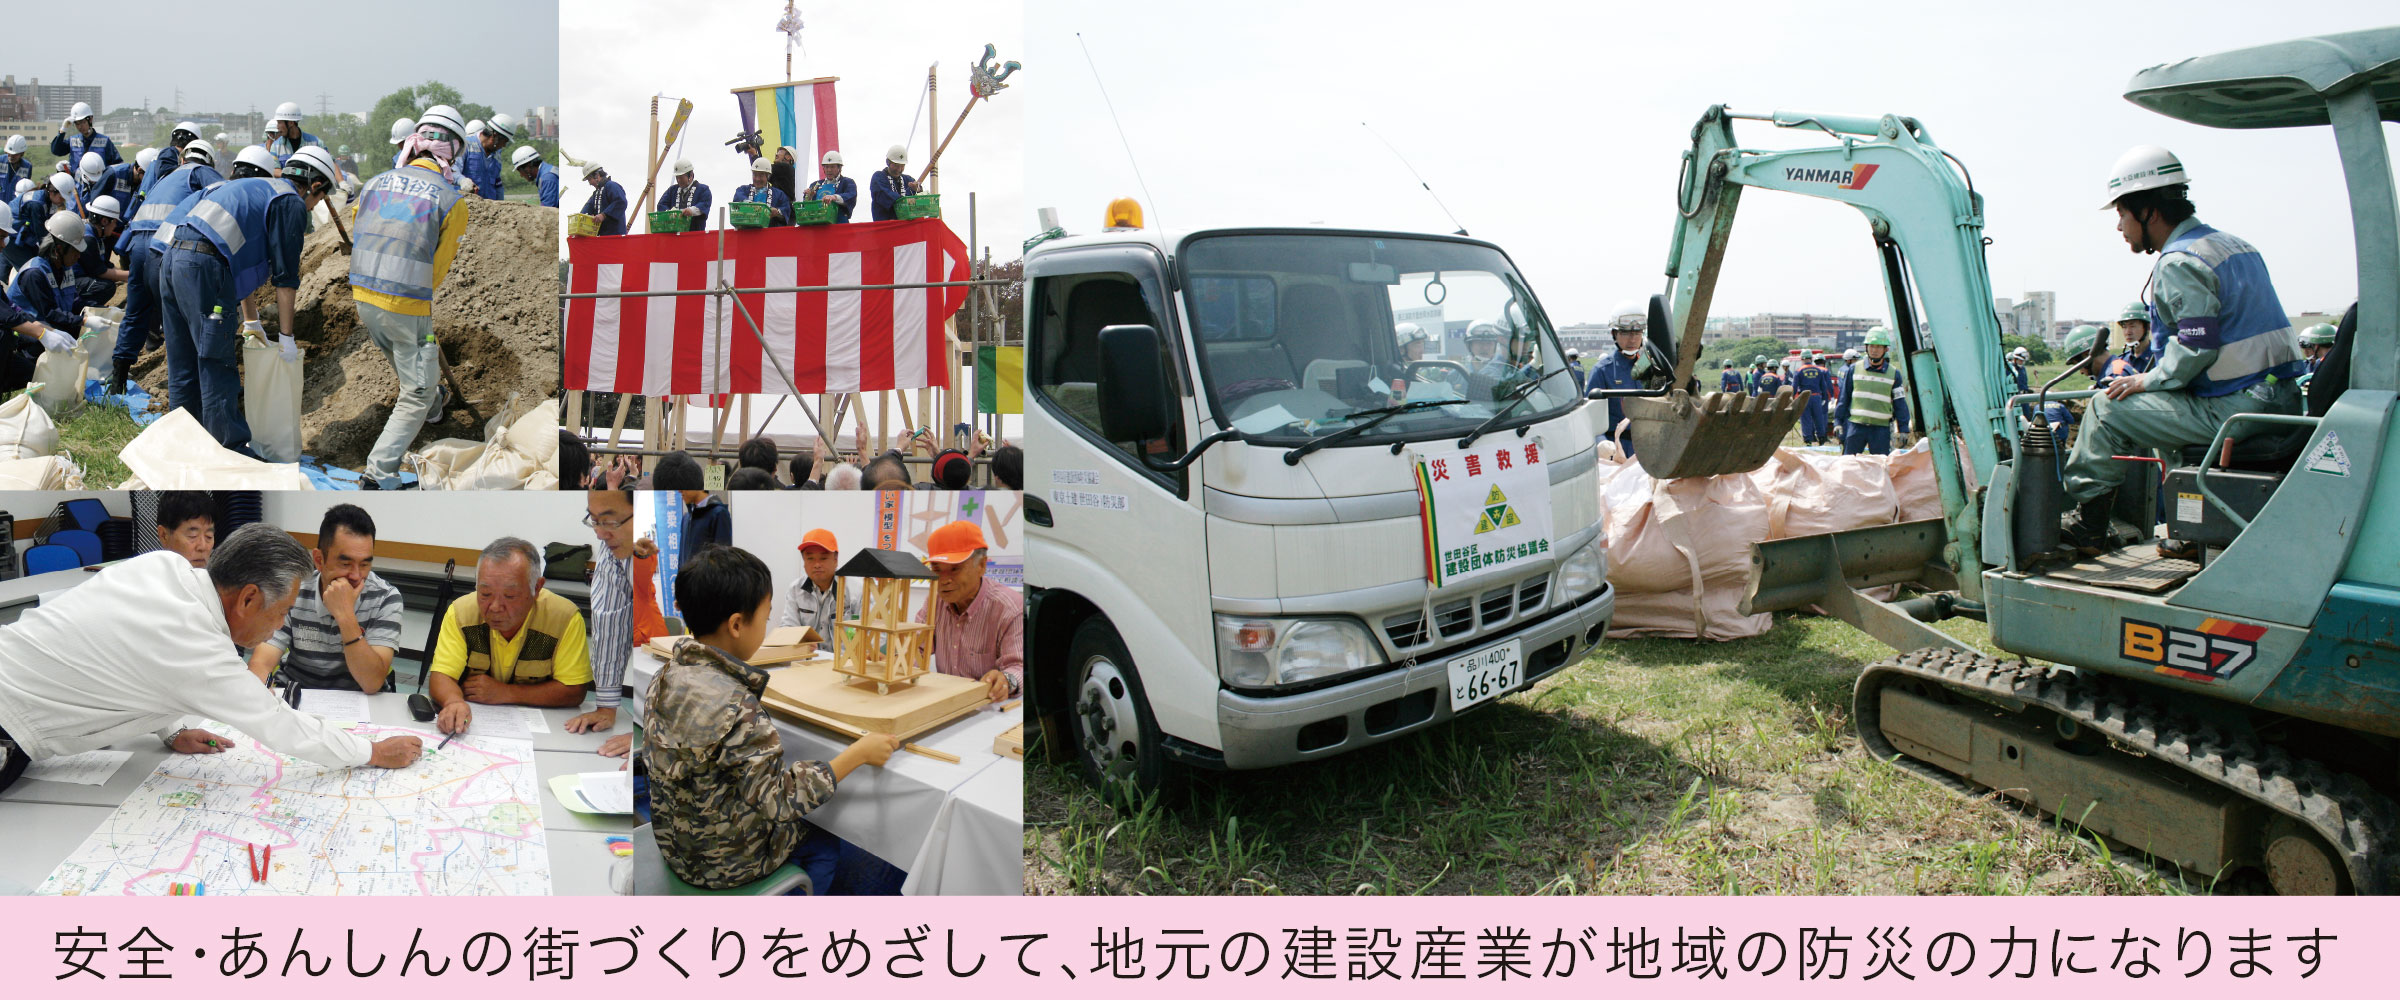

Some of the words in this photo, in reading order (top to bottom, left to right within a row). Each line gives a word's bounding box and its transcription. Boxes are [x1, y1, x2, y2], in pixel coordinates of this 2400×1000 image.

[1785, 167, 1853, 184] YANMAR
[1431, 443, 1540, 481] 災害救援
[1444, 544, 1478, 562] 世田谷区
[1445, 538, 1549, 577] 建設団体防災協議会
[2120, 617, 2257, 681] B27
[1456, 686, 1464, 700] と
[1468, 660, 1518, 700] 66-67
